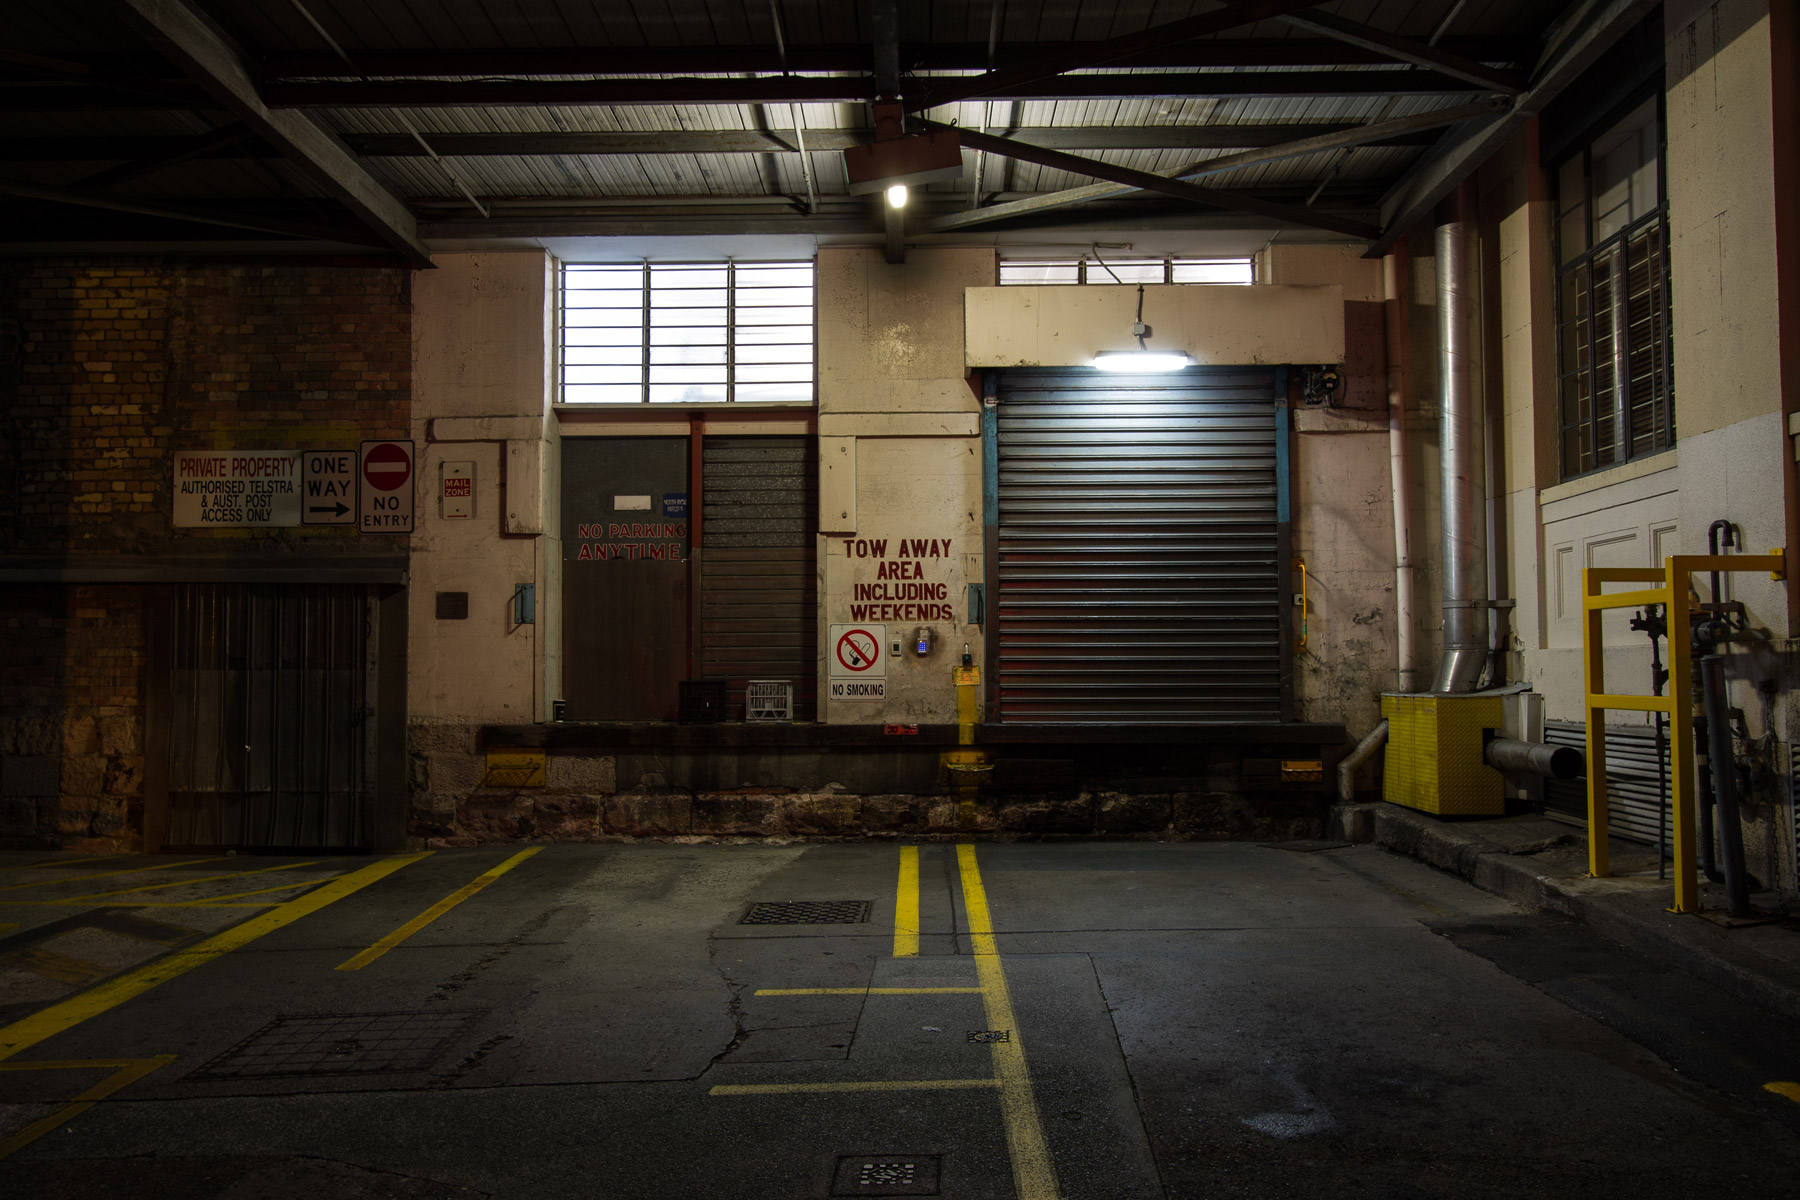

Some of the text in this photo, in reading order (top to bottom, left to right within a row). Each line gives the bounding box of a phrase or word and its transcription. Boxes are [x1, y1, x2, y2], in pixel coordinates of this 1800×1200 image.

[180, 457, 295, 477] PRIVATE PROPERTY
[311, 457, 349, 474] ONE
[181, 480, 293, 494] AUTHORISED TELSTRA
[308, 480, 350, 496] WAY
[445, 479, 470, 487] MAIL
[445, 487, 470, 496] ZONE
[201, 494, 272, 507] & AUST. POST
[374, 496, 399, 510] NO
[201, 508, 272, 522] ACCESS ONLY
[364, 515, 409, 526] ENTRY
[578, 523, 687, 539] NO PARKING
[578, 543, 681, 560] ANYTIME
[843, 538, 952, 558] TOW AWAY
[877, 561, 924, 580] AREA
[854, 583, 947, 601] INCLUDING
[850, 603, 952, 621] WEEKENDS
[832, 684, 884, 696] NO SMOKING
